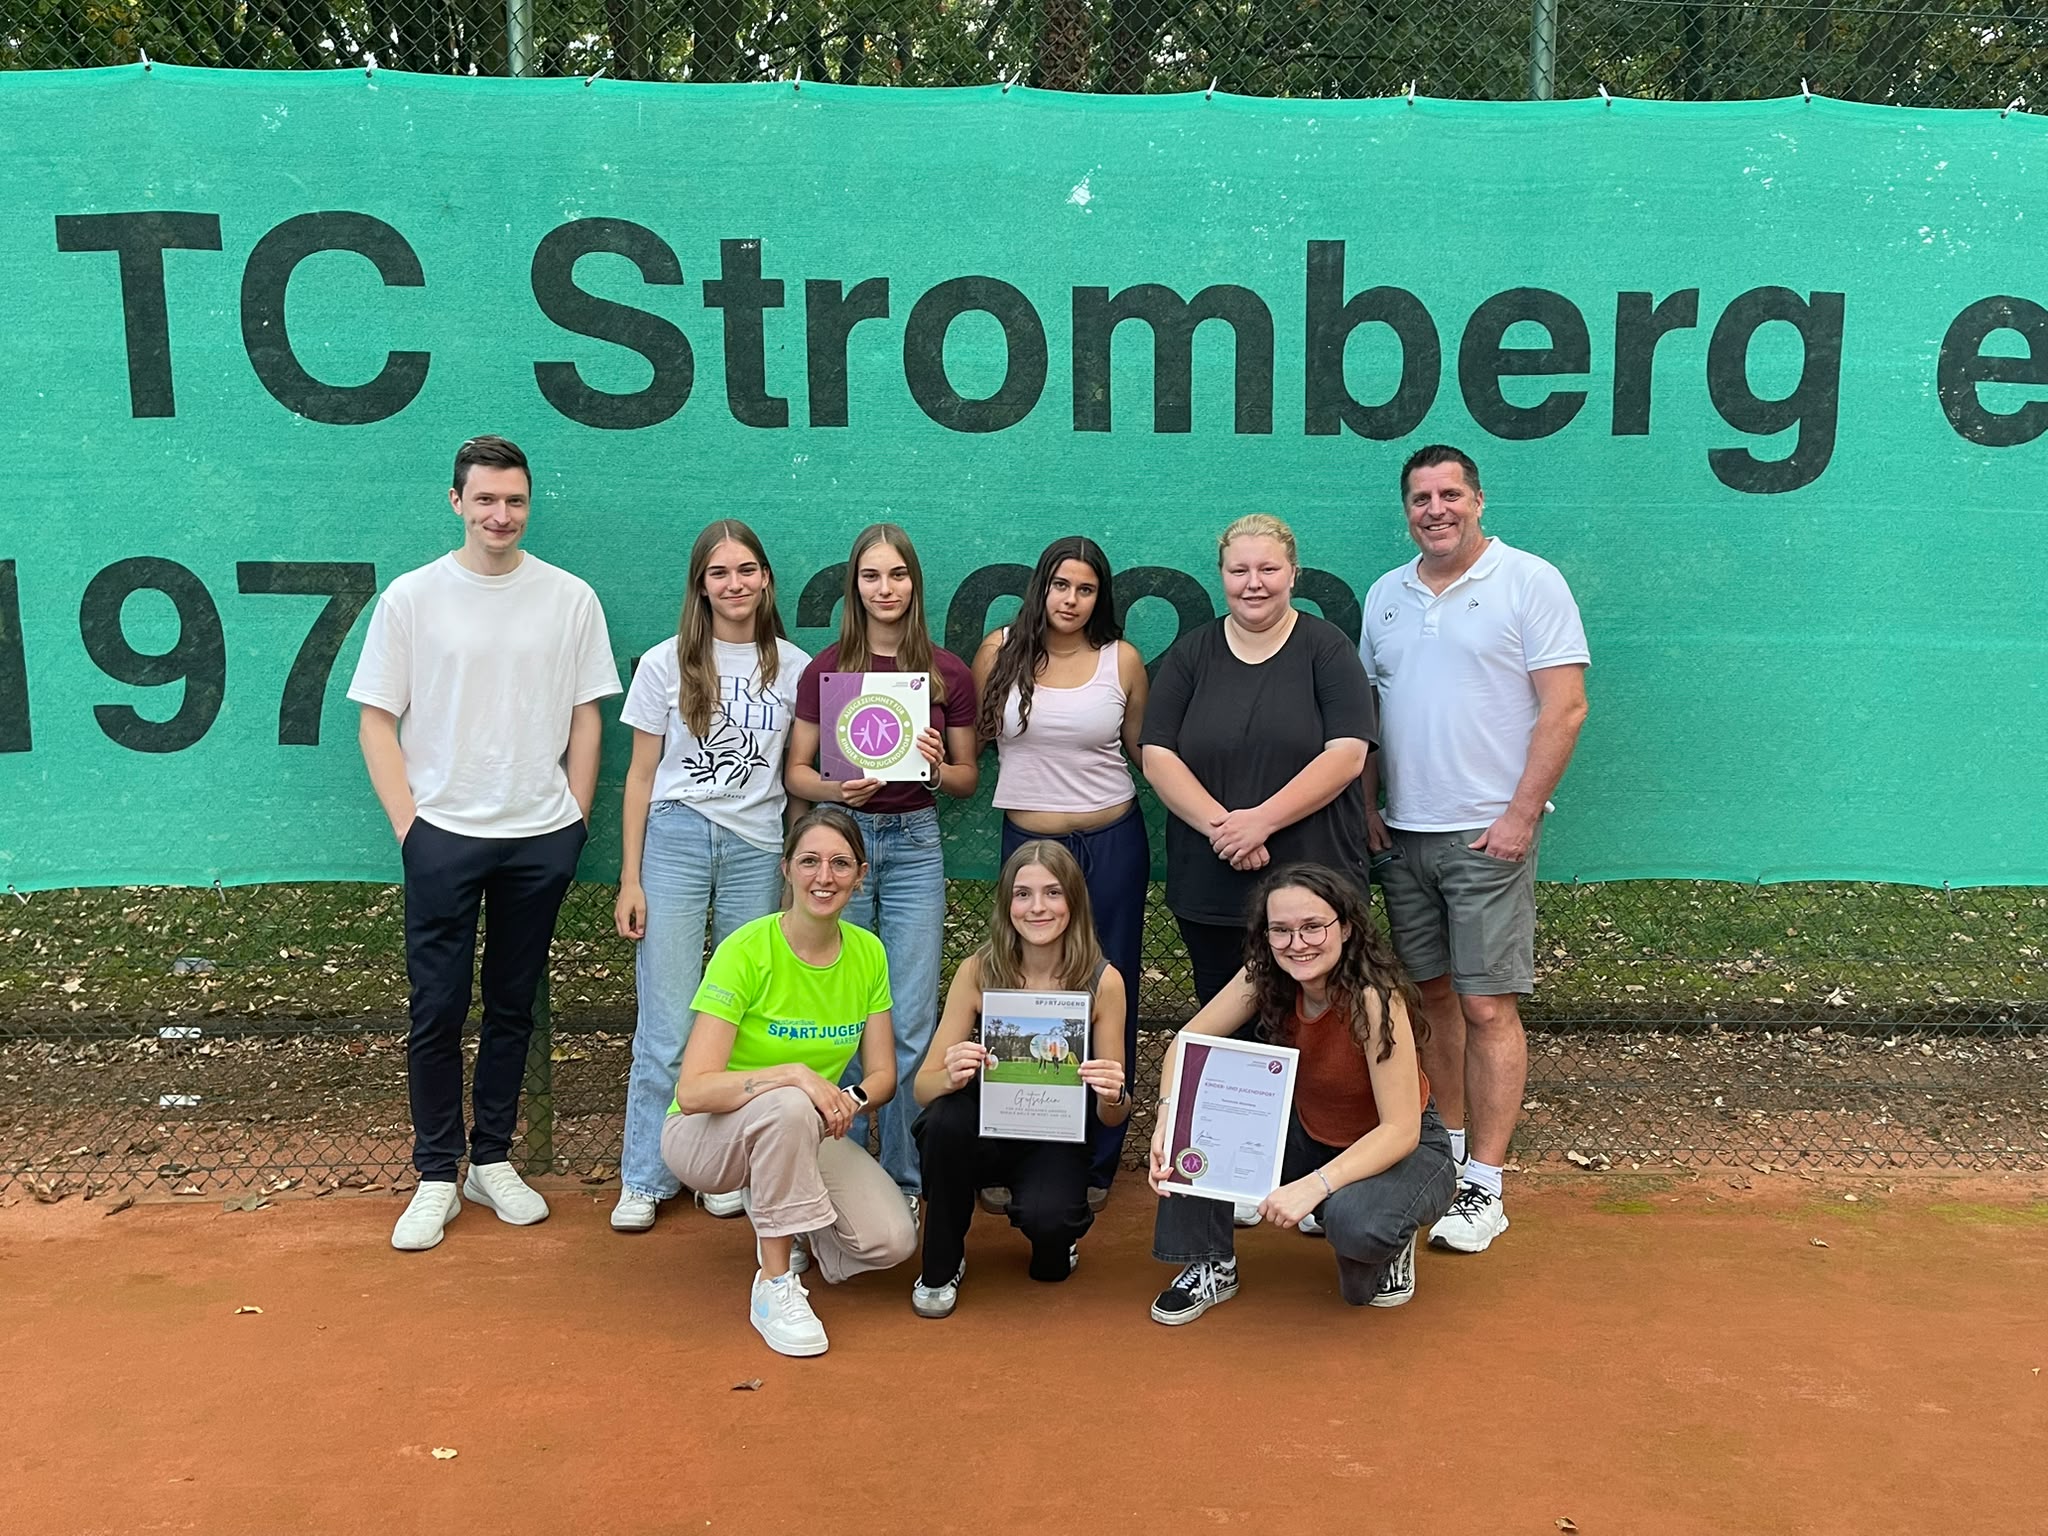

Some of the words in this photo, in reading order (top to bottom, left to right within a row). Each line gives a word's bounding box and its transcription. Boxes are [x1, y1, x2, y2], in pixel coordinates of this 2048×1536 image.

[55, 210, 432, 426] TC
[531, 216, 1846, 494] Stromberg
[0, 555, 377, 753] 197
[718, 675, 758, 703] ER
[844, 695, 894, 719] AUSGEZEICHNET
[893, 702, 905, 715] FÜR
[860, 759, 876, 767] UND
[876, 734, 911, 768] JUGENDSPORT
